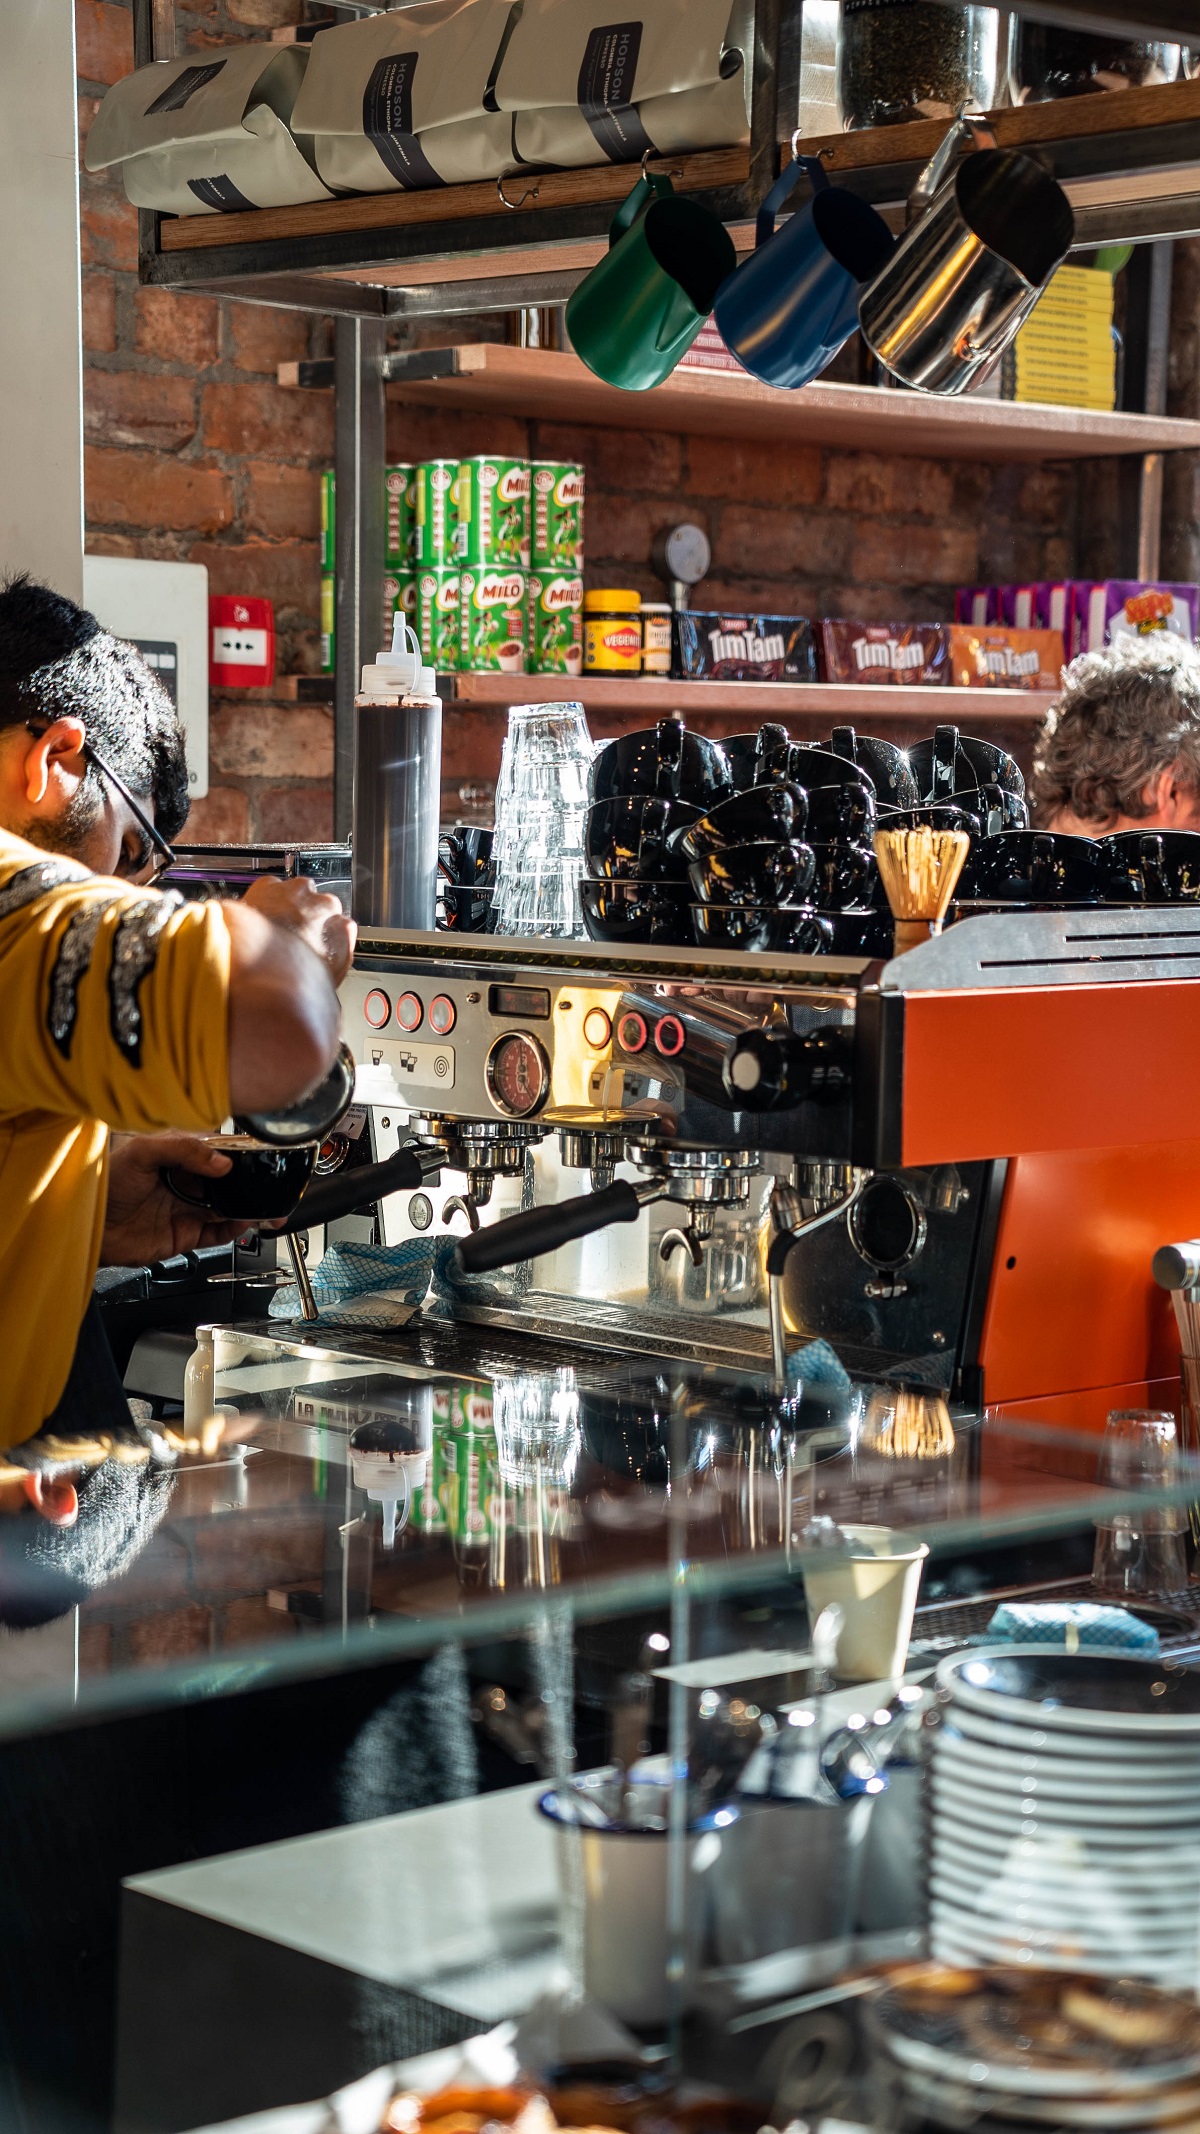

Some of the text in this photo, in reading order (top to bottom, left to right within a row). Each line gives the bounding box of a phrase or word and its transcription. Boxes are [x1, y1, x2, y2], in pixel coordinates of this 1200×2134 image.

[600, 35, 611, 69] ESPRESSO
[611, 33, 630, 100] HODSON
[380, 64, 392, 96] ESPRESSO
[393, 63, 407, 128] HODSON
[606, 107, 628, 142] GUATEMALA
[390, 134, 411, 166] GUATEMALA
[206, 178, 226, 200] ATEMALA
[482, 584, 520, 600] MILO
[298, 1401, 314, 1418] LA
